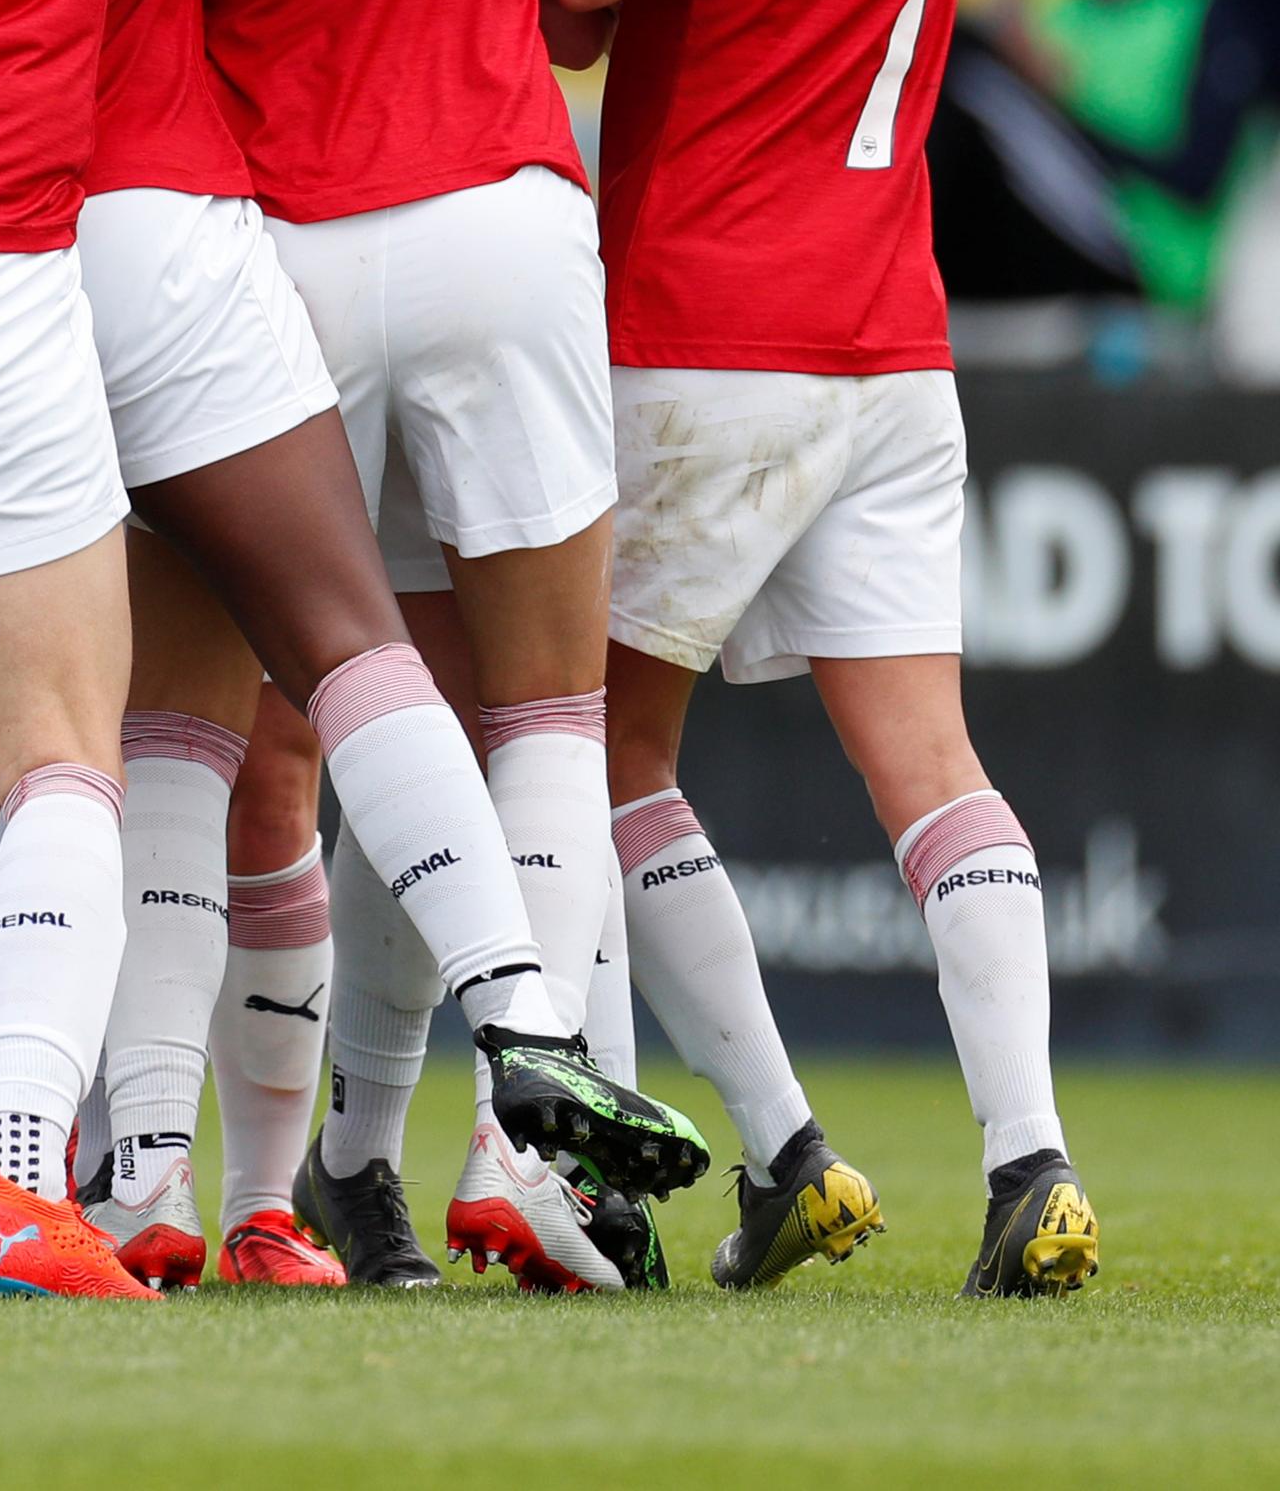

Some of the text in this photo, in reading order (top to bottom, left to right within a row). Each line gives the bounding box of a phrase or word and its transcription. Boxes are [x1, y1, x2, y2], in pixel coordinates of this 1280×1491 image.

[389, 847, 462, 899] SENAL
[641, 854, 722, 891] ARSEN
[937, 868, 1042, 902] ARSENAL
[141, 890, 229, 924] ARSENA
